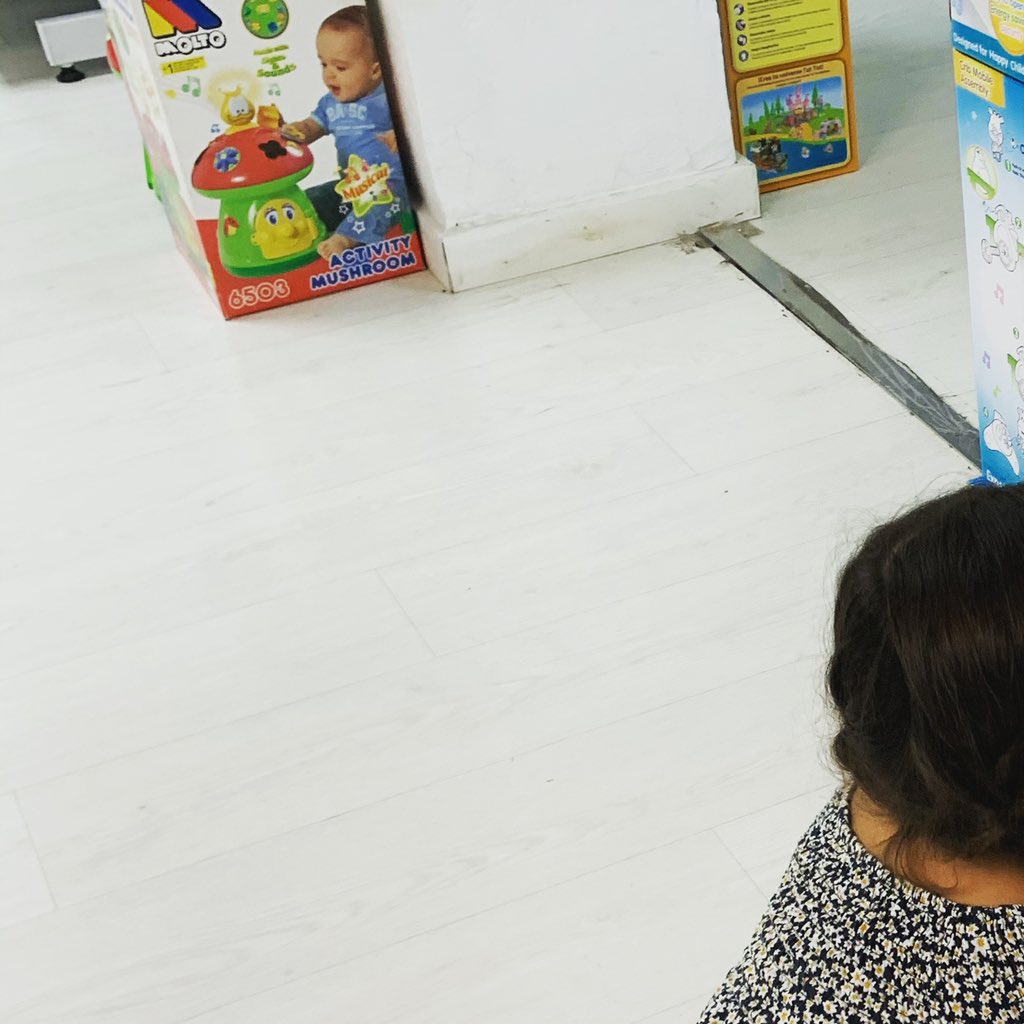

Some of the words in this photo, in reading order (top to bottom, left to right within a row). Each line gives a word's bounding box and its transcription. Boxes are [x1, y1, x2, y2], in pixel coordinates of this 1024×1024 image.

[154, 30, 226, 57] MOLTO
[989, 50, 1009, 69] Happy
[257, 64, 296, 77] Sounds
[342, 164, 390, 200] Musical
[330, 233, 412, 268] ACTIVITY
[310, 251, 416, 290] MUSHROOM
[228, 278, 290, 310] 6503
